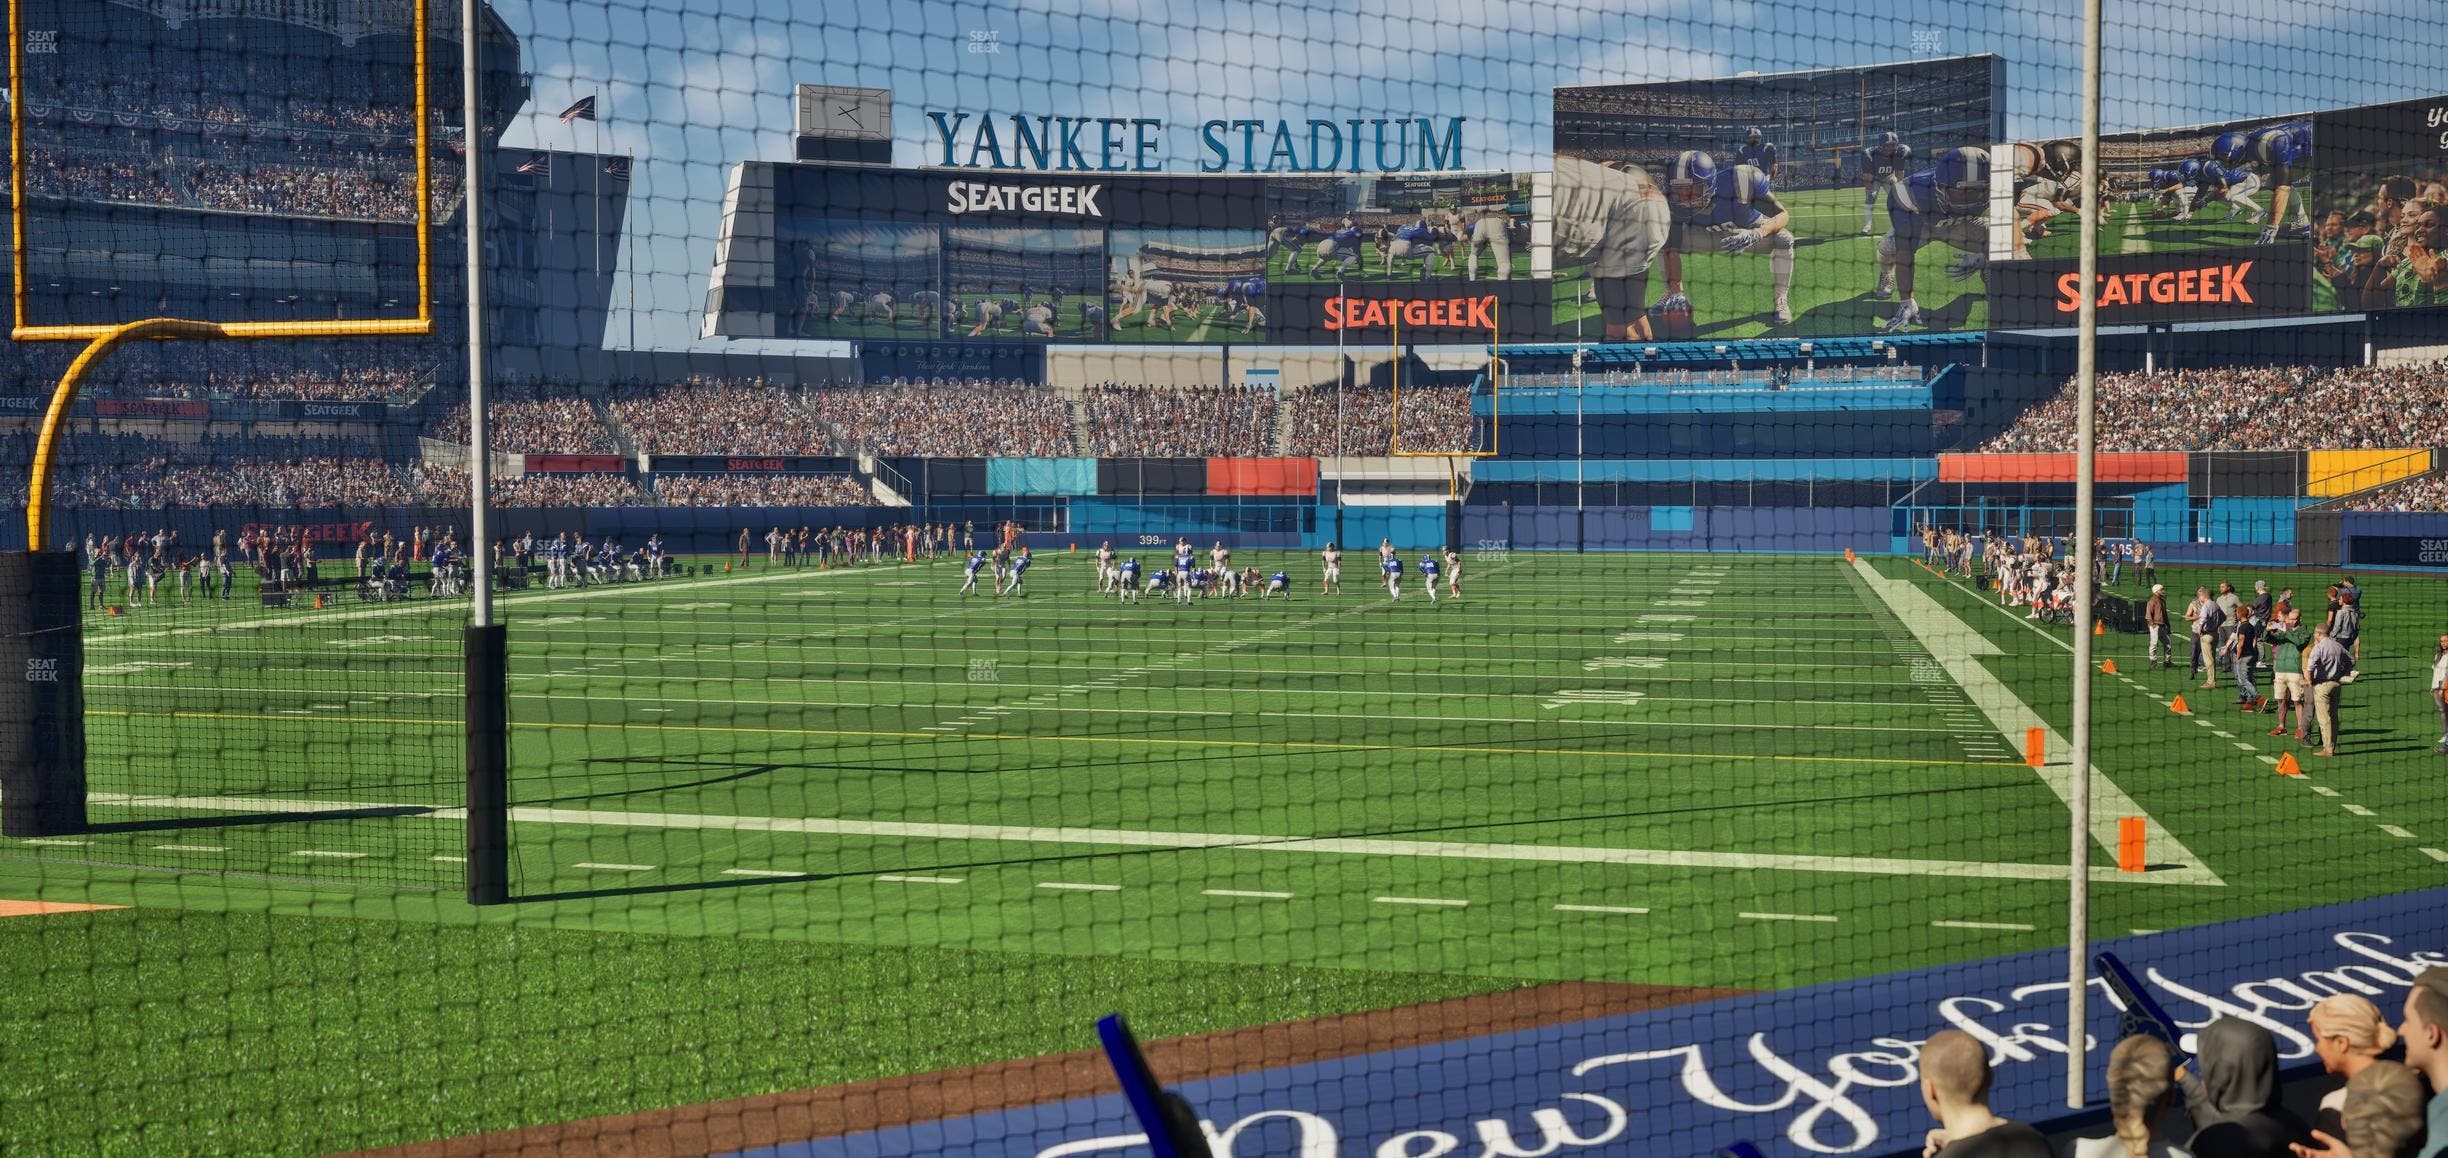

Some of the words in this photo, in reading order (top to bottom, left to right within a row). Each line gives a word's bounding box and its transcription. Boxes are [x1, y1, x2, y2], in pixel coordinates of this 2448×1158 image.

[926, 111, 1162, 171] YANKEE
[1200, 115, 1468, 174] STADIUM
[948, 180, 1102, 216] SEATGEEK
[1323, 295, 1496, 330] SEATGEEK
[304, 403, 360, 416] SEATGEEK
[727, 458, 785, 471] SEATGEEK
